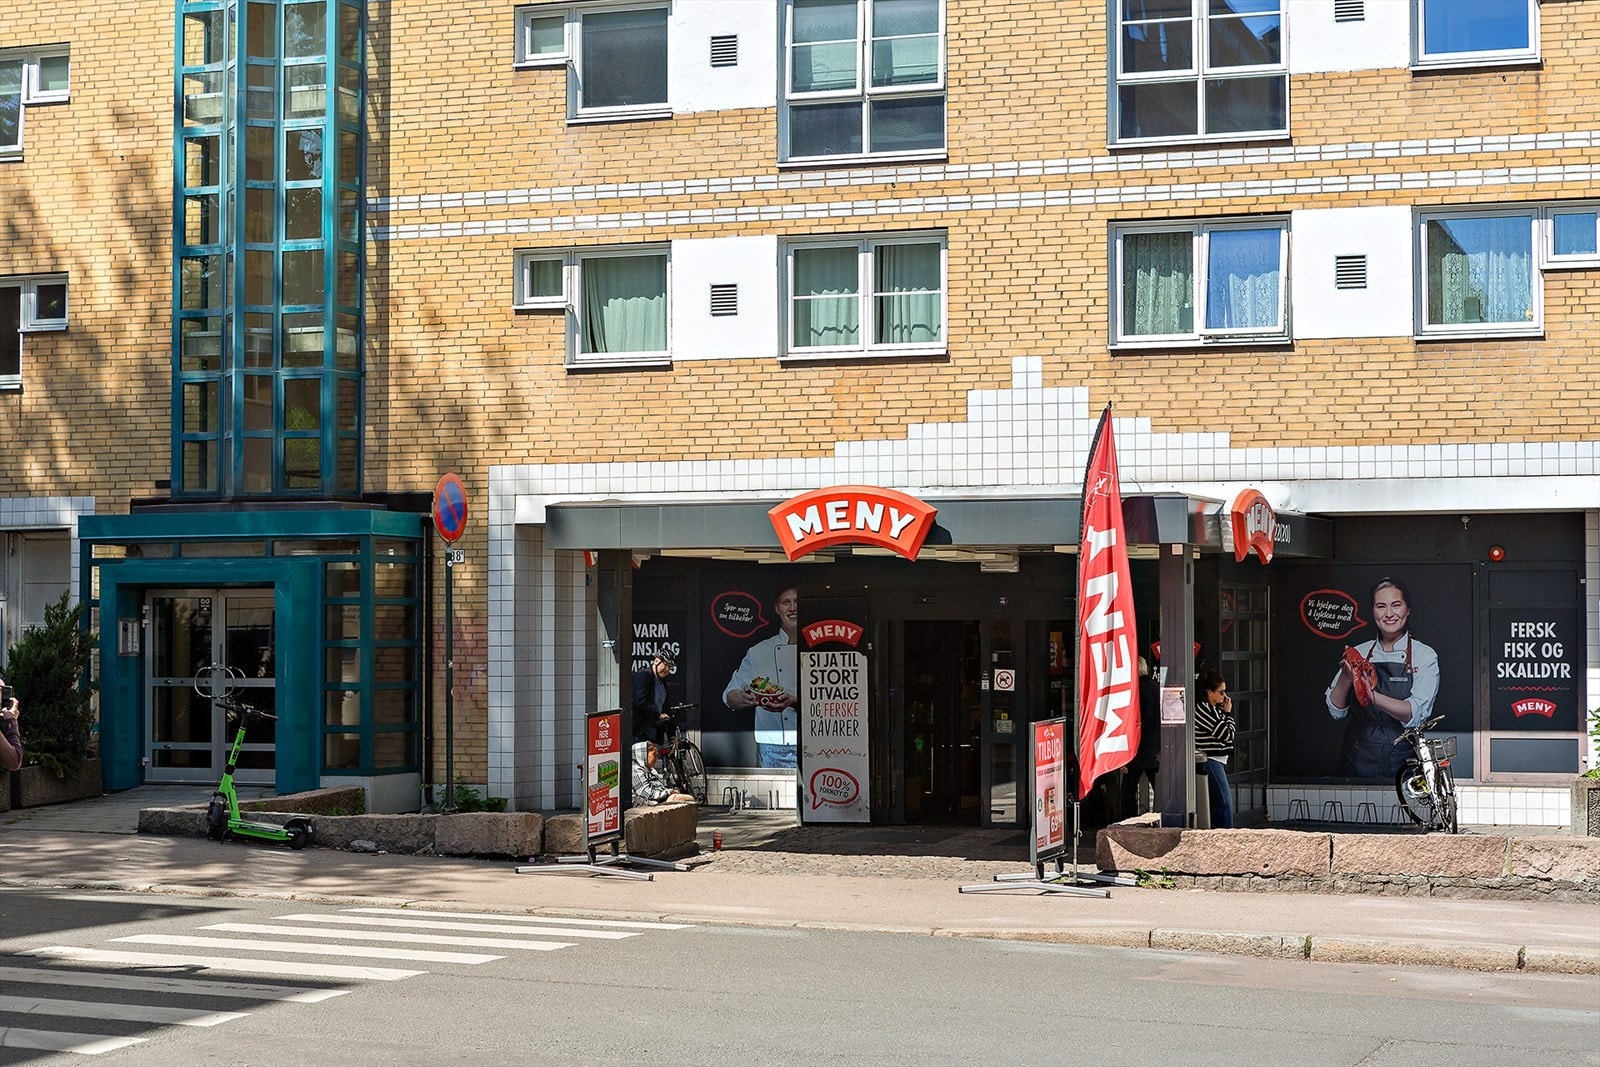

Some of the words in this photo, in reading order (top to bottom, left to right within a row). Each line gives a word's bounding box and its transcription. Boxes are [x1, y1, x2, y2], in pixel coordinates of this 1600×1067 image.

[786, 500, 915, 542] MENY
[1246, 503, 1277, 542] MENY
[737, 607, 750, 617] meg
[1313, 609, 1336, 621] lykkes
[1337, 613, 1352, 621] med
[1316, 600, 1340, 611] hjelper
[1341, 603, 1354, 616] deg
[633, 623, 669, 638] VARM
[809, 624, 858, 641] MENY
[1511, 622, 1557, 638] FERSK
[1085, 525, 1131, 760] MENY
[1504, 642, 1537, 658] FISK
[1541, 642, 1564, 658] OG
[809, 652, 820, 668] SI
[823, 652, 839, 668] JA
[840, 652, 859, 668] TIL
[810, 668, 859, 685] STORT
[1496, 662, 1572, 679] SKALLDYR
[809, 686, 860, 700] UTVALG
[810, 702, 821, 717] OG
[824, 702, 859, 717] FERSKE
[1516, 702, 1552, 713] MENY
[810, 715, 860, 737] RÅVARER
[1037, 737, 1062, 762] TILBUD
[822, 773, 851, 792] 100%
